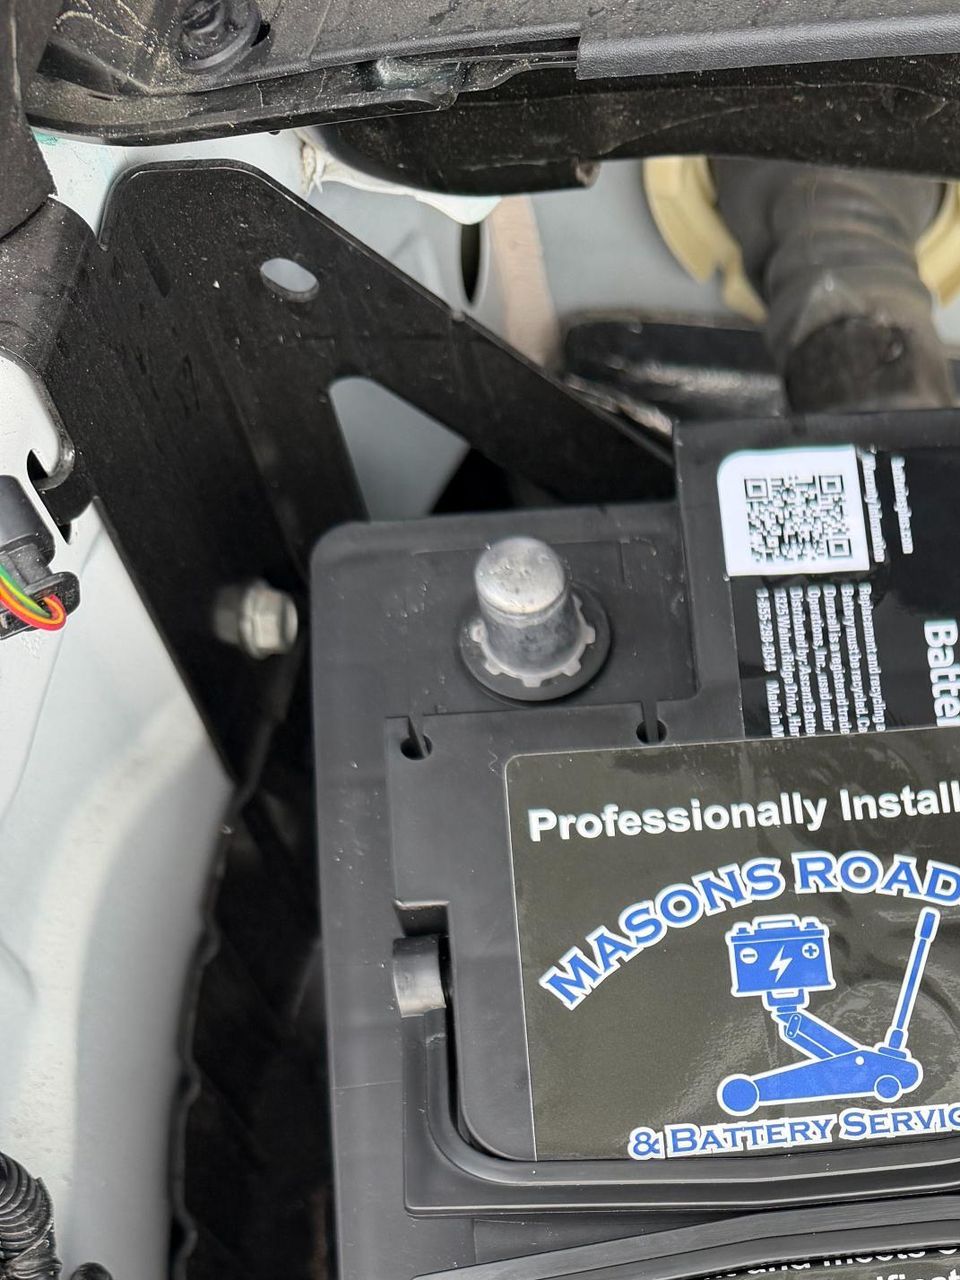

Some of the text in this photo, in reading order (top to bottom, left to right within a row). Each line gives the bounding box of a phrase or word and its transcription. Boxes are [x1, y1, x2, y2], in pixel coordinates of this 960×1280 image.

[774, 587, 789, 615] 1325
[790, 586, 809, 652] Distributed
[807, 585, 824, 649] Operations,
[823, 584, 841, 632] Duracell
[841, 583, 855, 626] Battery
[859, 582, 877, 651] Replacement
[756, 588, 777, 672] 1-855-298-0344
[777, 615, 792, 655] Walnut
[829, 631, 841, 643] is
[846, 625, 860, 653] must
[780, 653, 795, 684] Ridge
[830, 650, 849, 706] registered
[849, 651, 861, 669] be
[867, 650, 881, 674] and
[766, 680, 781, 714] Made
[784, 683, 799, 716] Drive,
[798, 665, 813, 705] Ascent
[818, 672, 832, 700] used
[851, 668, 868, 717] recycled.
[869, 673, 886, 723] recycling
[769, 712, 782, 726] in
[820, 700, 835, 732] under
[528, 794, 827, 842] Professionally
[539, 856, 786, 1010] MASONS
[628, 1127, 664, 1159] &
[666, 1115, 836, 1157] BATTERY
